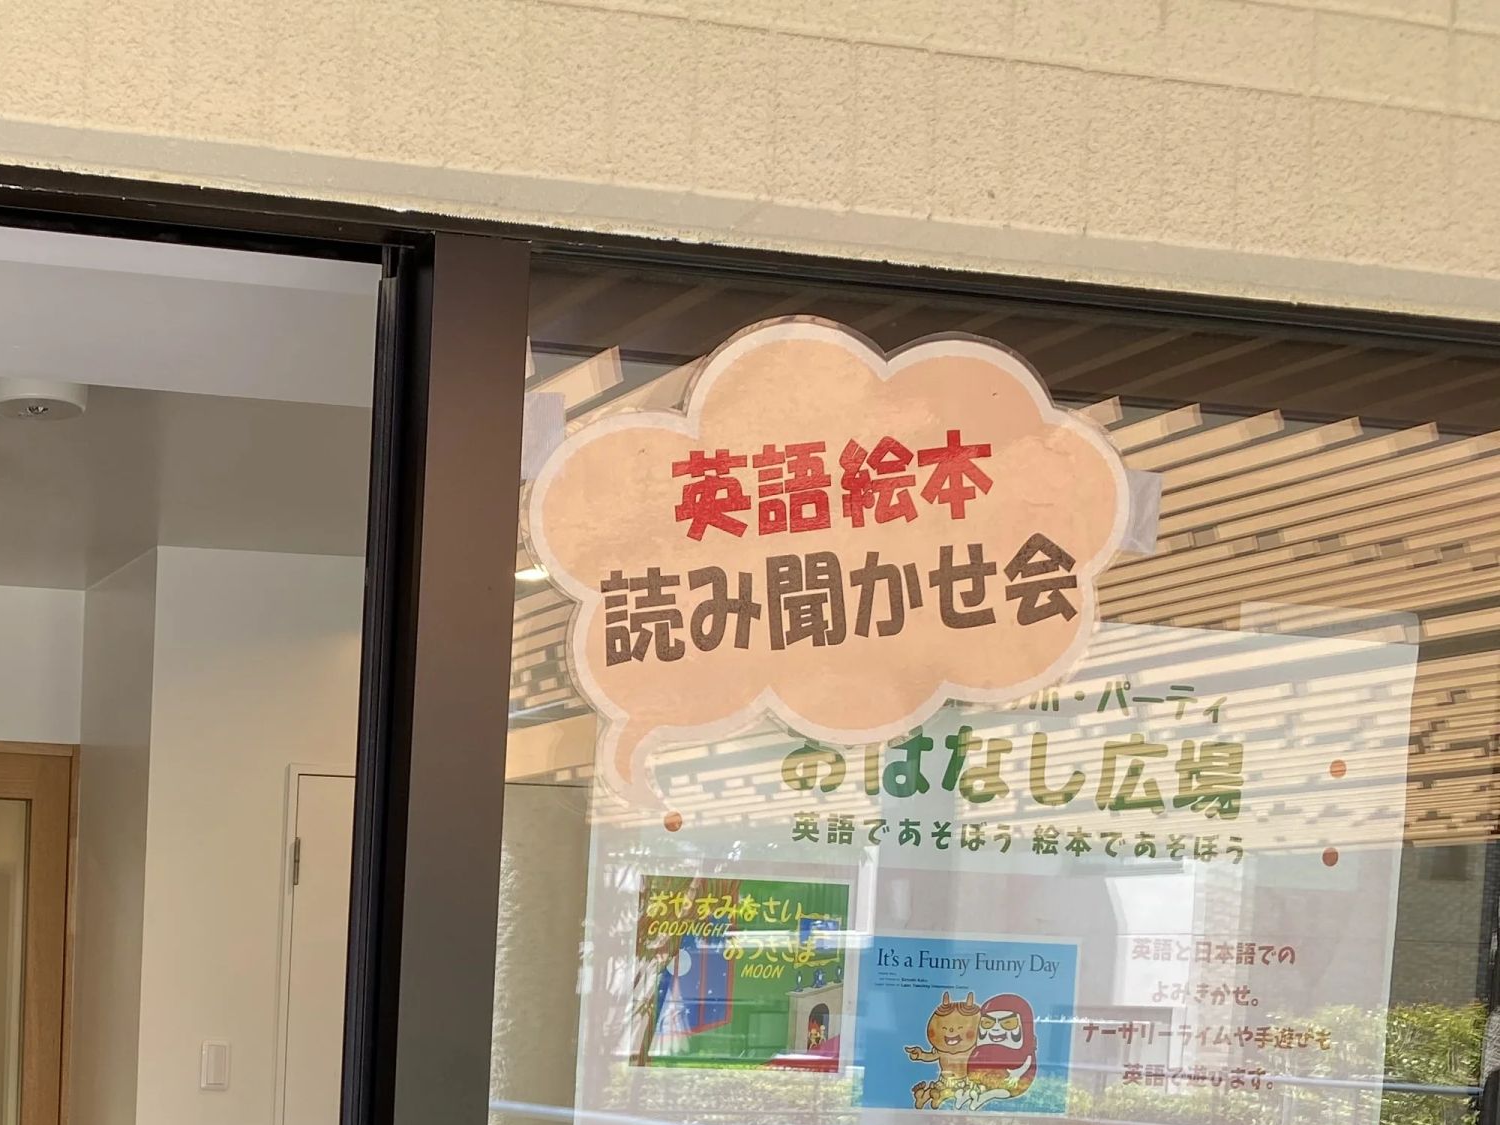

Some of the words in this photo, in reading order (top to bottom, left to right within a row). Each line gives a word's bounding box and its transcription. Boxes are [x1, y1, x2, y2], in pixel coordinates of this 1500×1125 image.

[671, 430, 991, 541] 英語絵本
[600, 532, 1078, 666] 読み聞かせ会
[791, 811, 1012, 854] 英語であそぼう
[1031, 823, 1245, 865] 絵本であそぼう
[646, 891, 802, 923] おやすみなさい
[648, 920, 732, 937] GOODNIGHT
[877, 947, 900, 967] It's
[903, 954, 913, 968] a
[918, 950, 970, 977] Funny
[975, 952, 1026, 978] Funny
[1029, 954, 1060, 979] Day
[1131, 937, 1296, 966] 英語と日本語での
[740, 964, 785, 979] MOON
